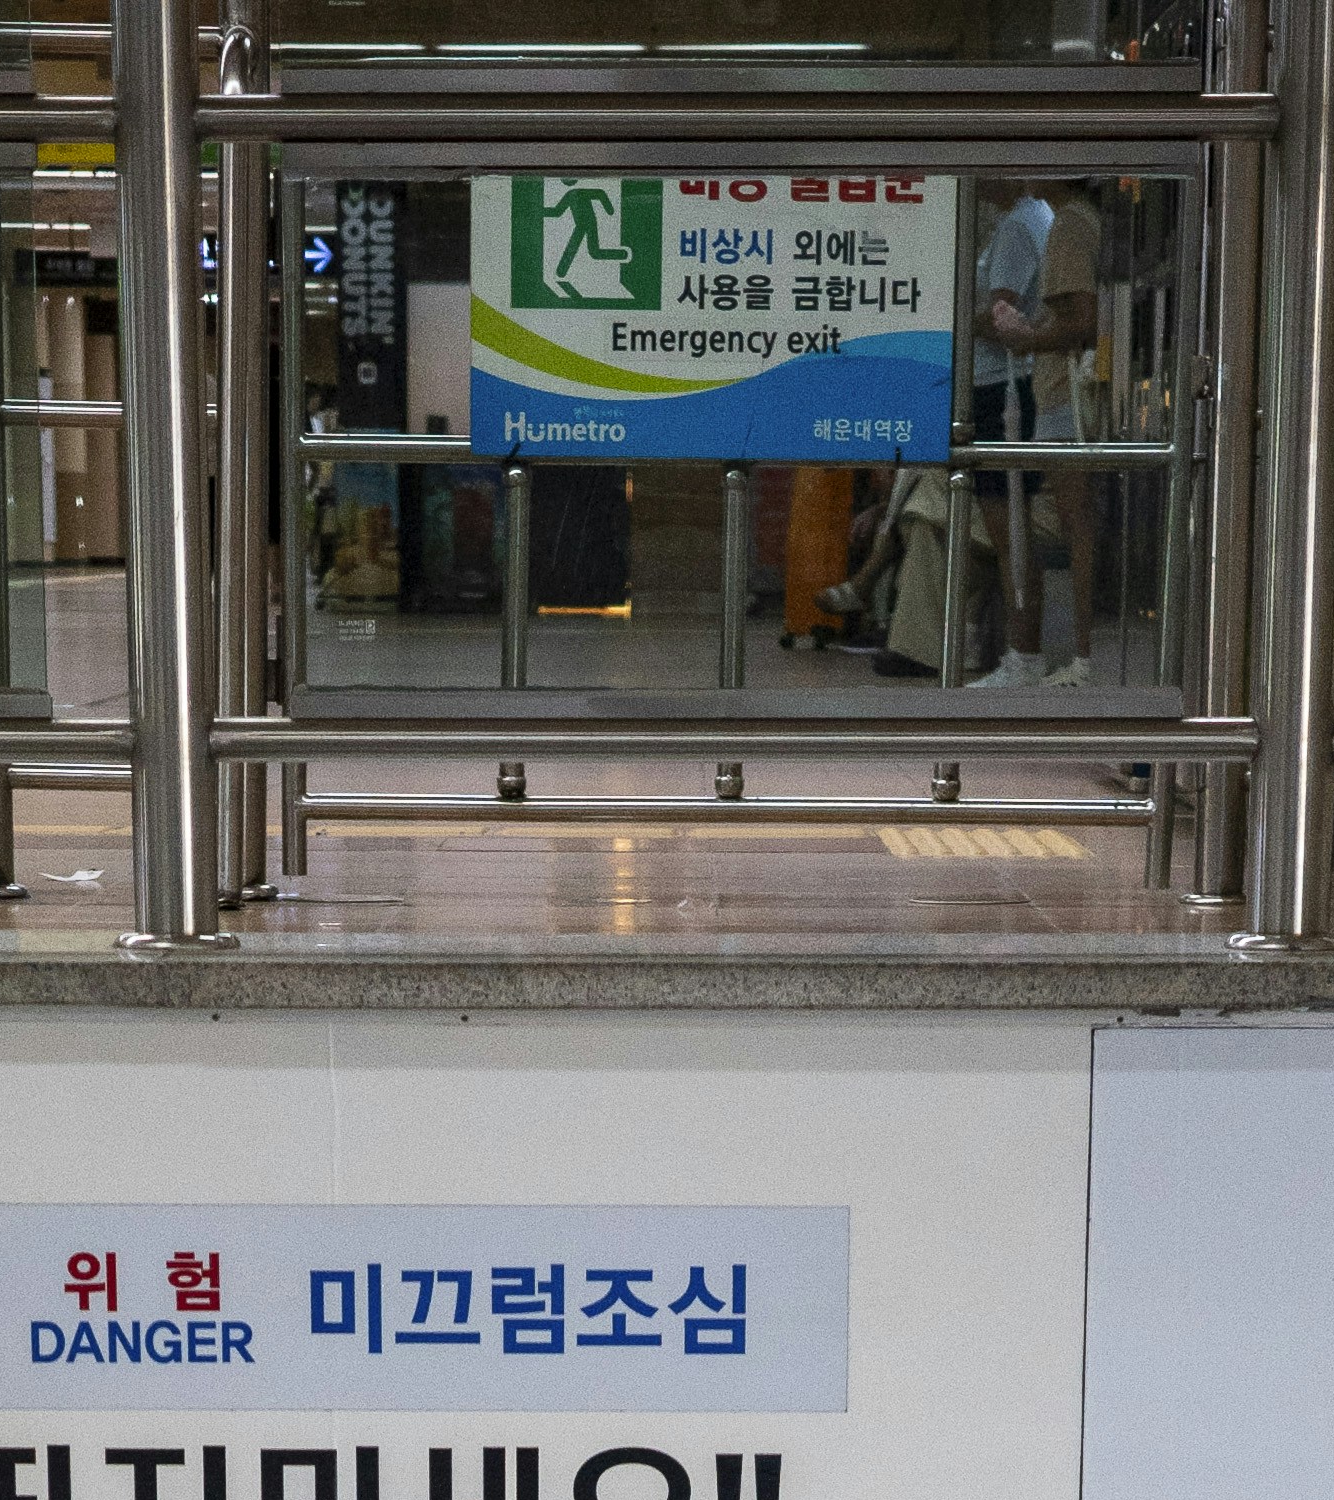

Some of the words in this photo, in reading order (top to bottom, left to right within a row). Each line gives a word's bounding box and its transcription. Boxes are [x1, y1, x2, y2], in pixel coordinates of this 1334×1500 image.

[679, 228, 774, 265] 비상시
[793, 229, 890, 266] 외에는
[677, 274, 774, 311] 사용을
[791, 276, 922, 313] 금합니다
[611, 322, 775, 358] Emergency
[787, 324, 842, 354] exit
[813, 418, 913, 442] 해운대역장
[310, 1264, 747, 1355] 미끄럼조심
[30, 1320, 255, 1364] DANGER
